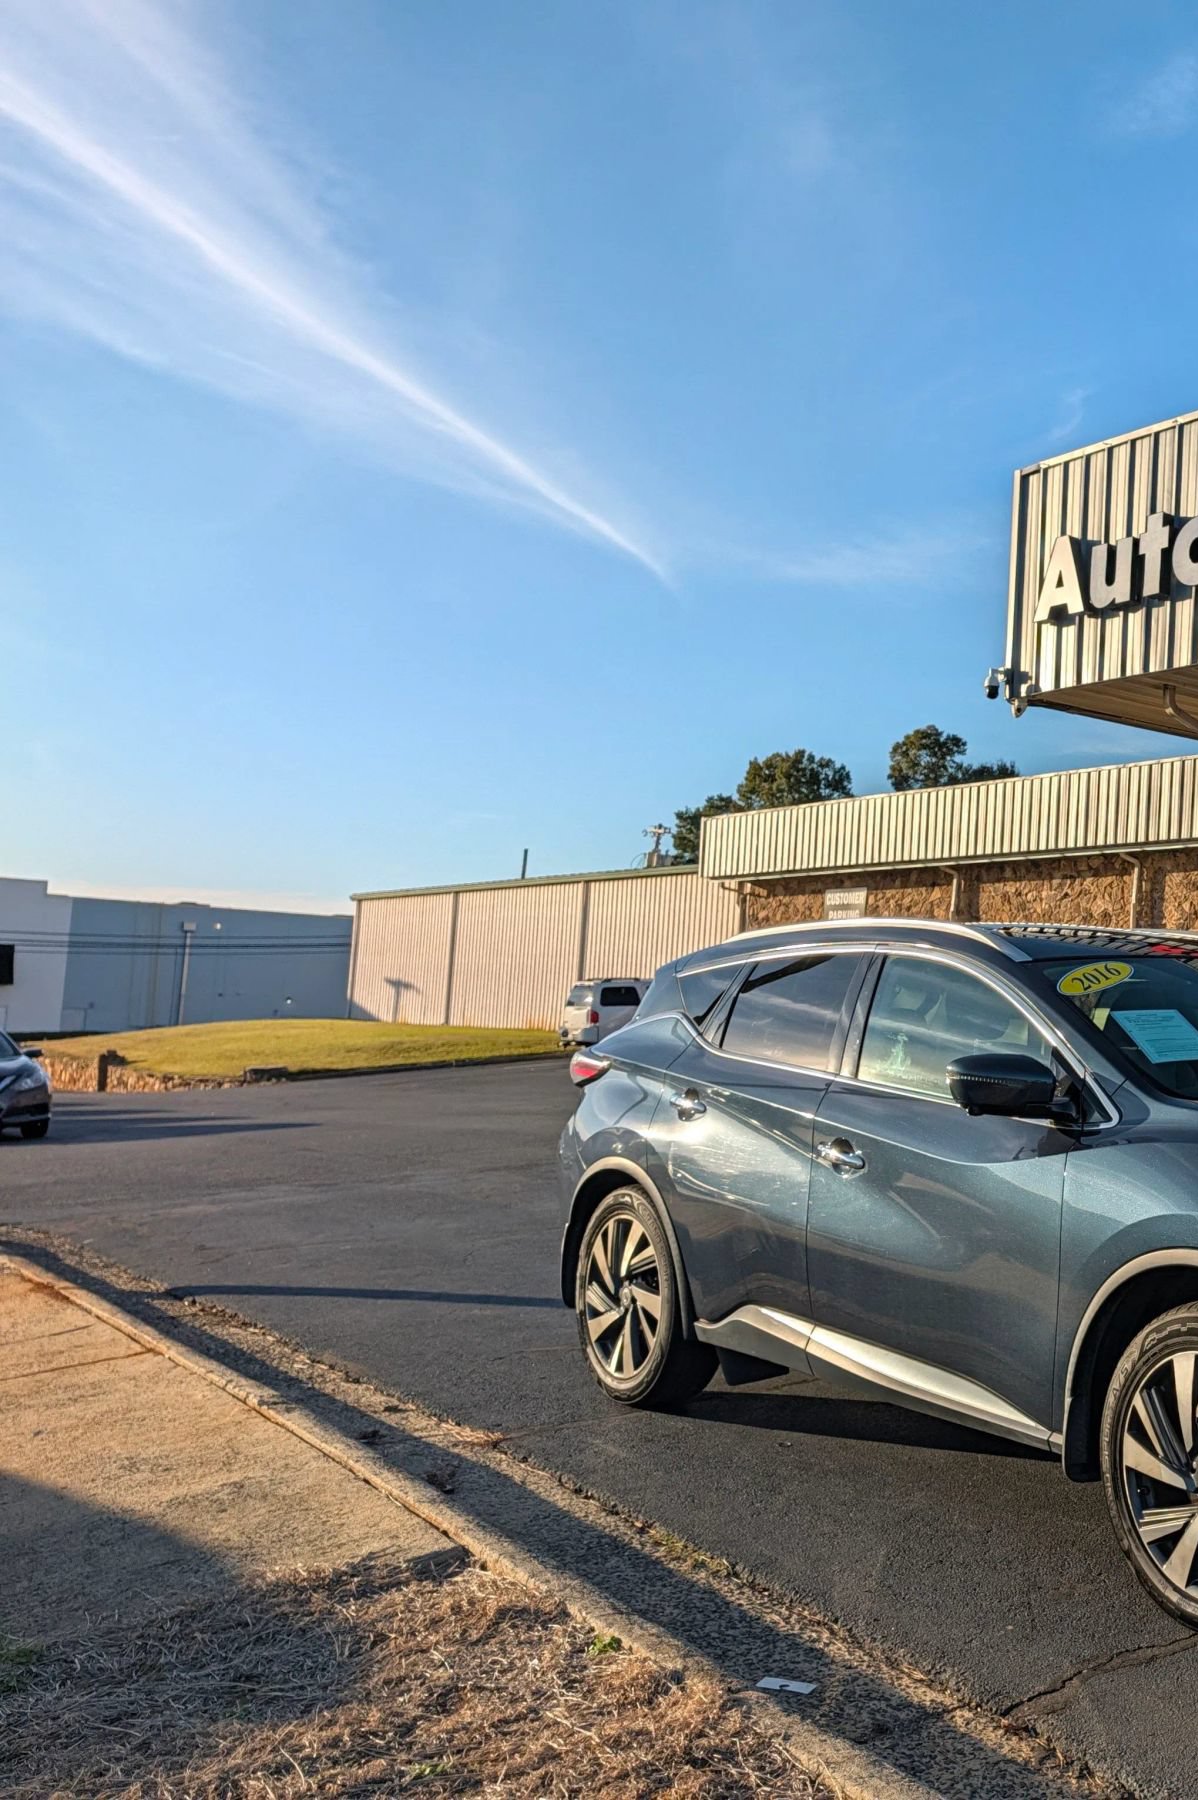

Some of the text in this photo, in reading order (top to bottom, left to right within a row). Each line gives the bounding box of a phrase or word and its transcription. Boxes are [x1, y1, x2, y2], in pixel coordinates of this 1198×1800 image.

[826, 892, 864, 905] CUSTOMER
[829, 910, 860, 920] PARKING
[1071, 963, 1121, 991] 2016
